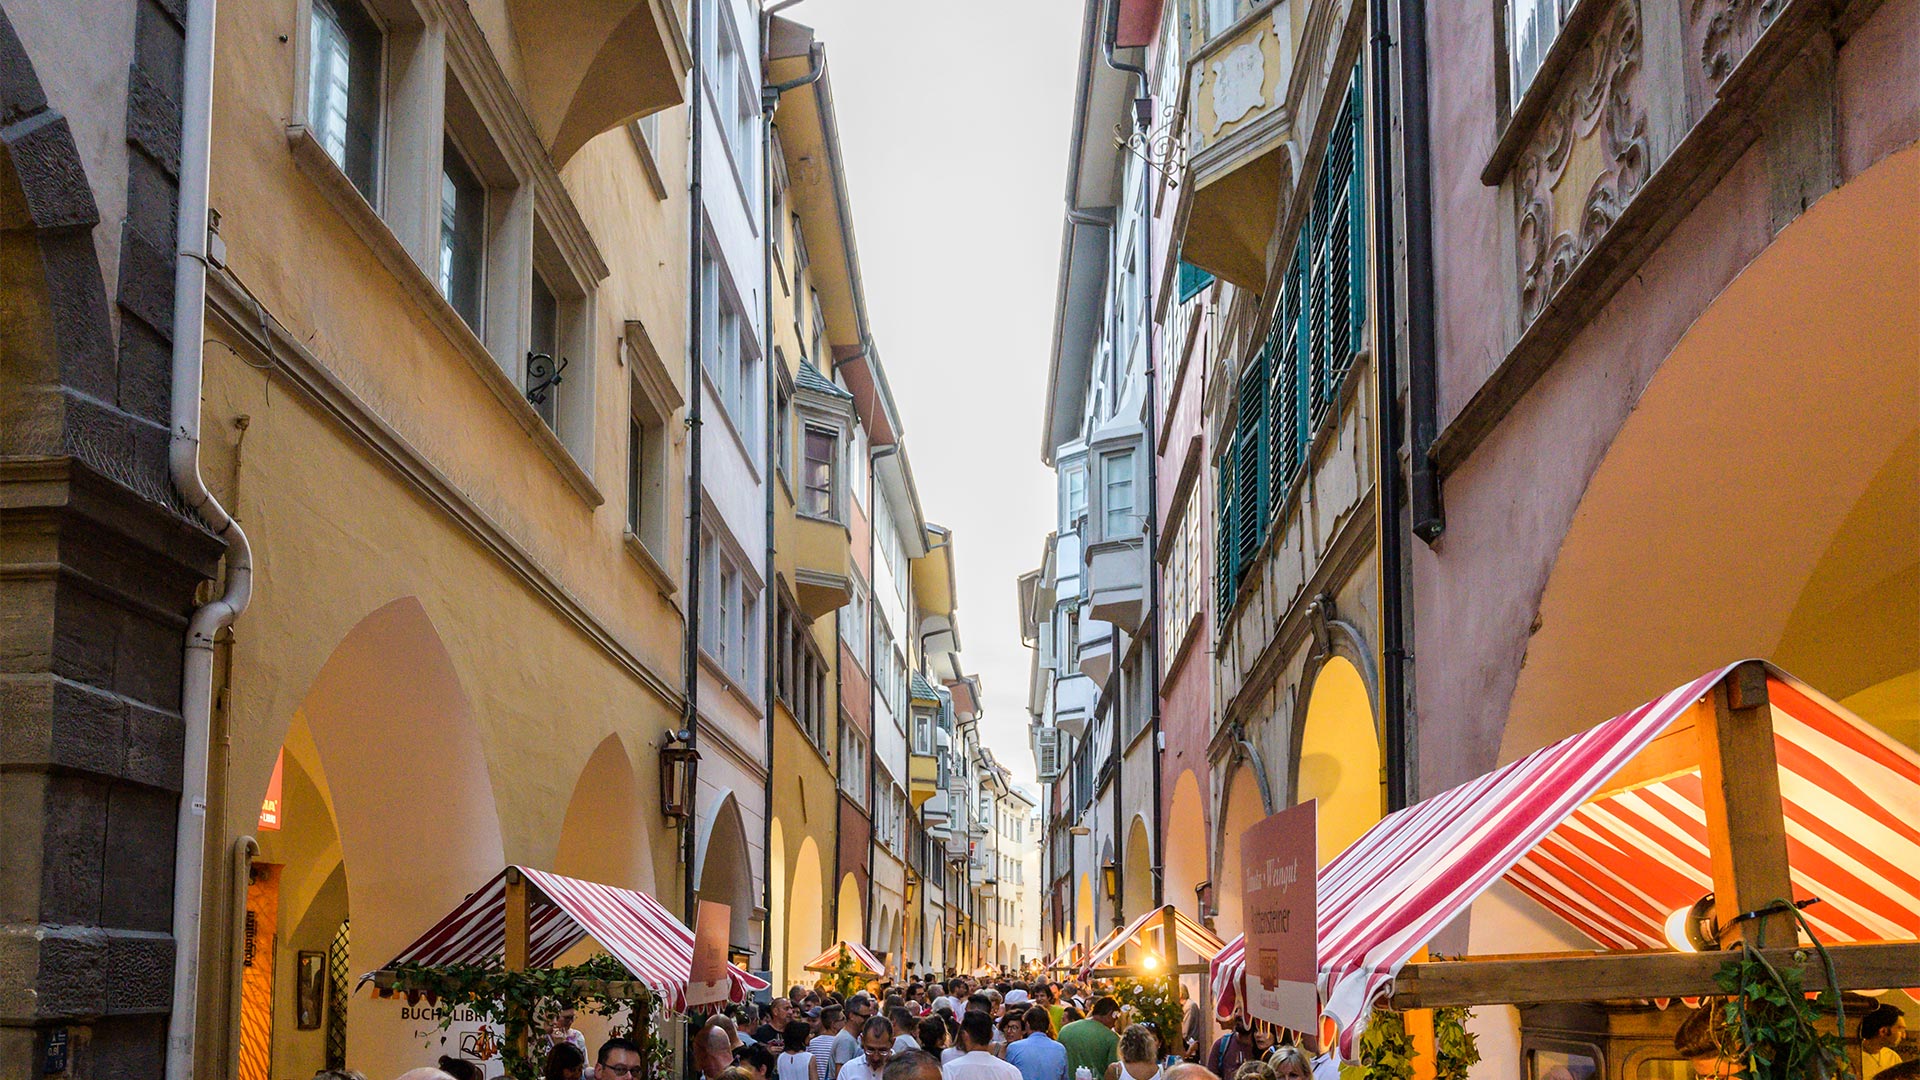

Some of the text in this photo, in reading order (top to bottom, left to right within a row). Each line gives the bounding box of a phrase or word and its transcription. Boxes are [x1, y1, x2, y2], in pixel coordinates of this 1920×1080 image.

[1266, 857, 1298, 895] Weingut
[401, 1007, 488, 1022] BUCH LIBRI
